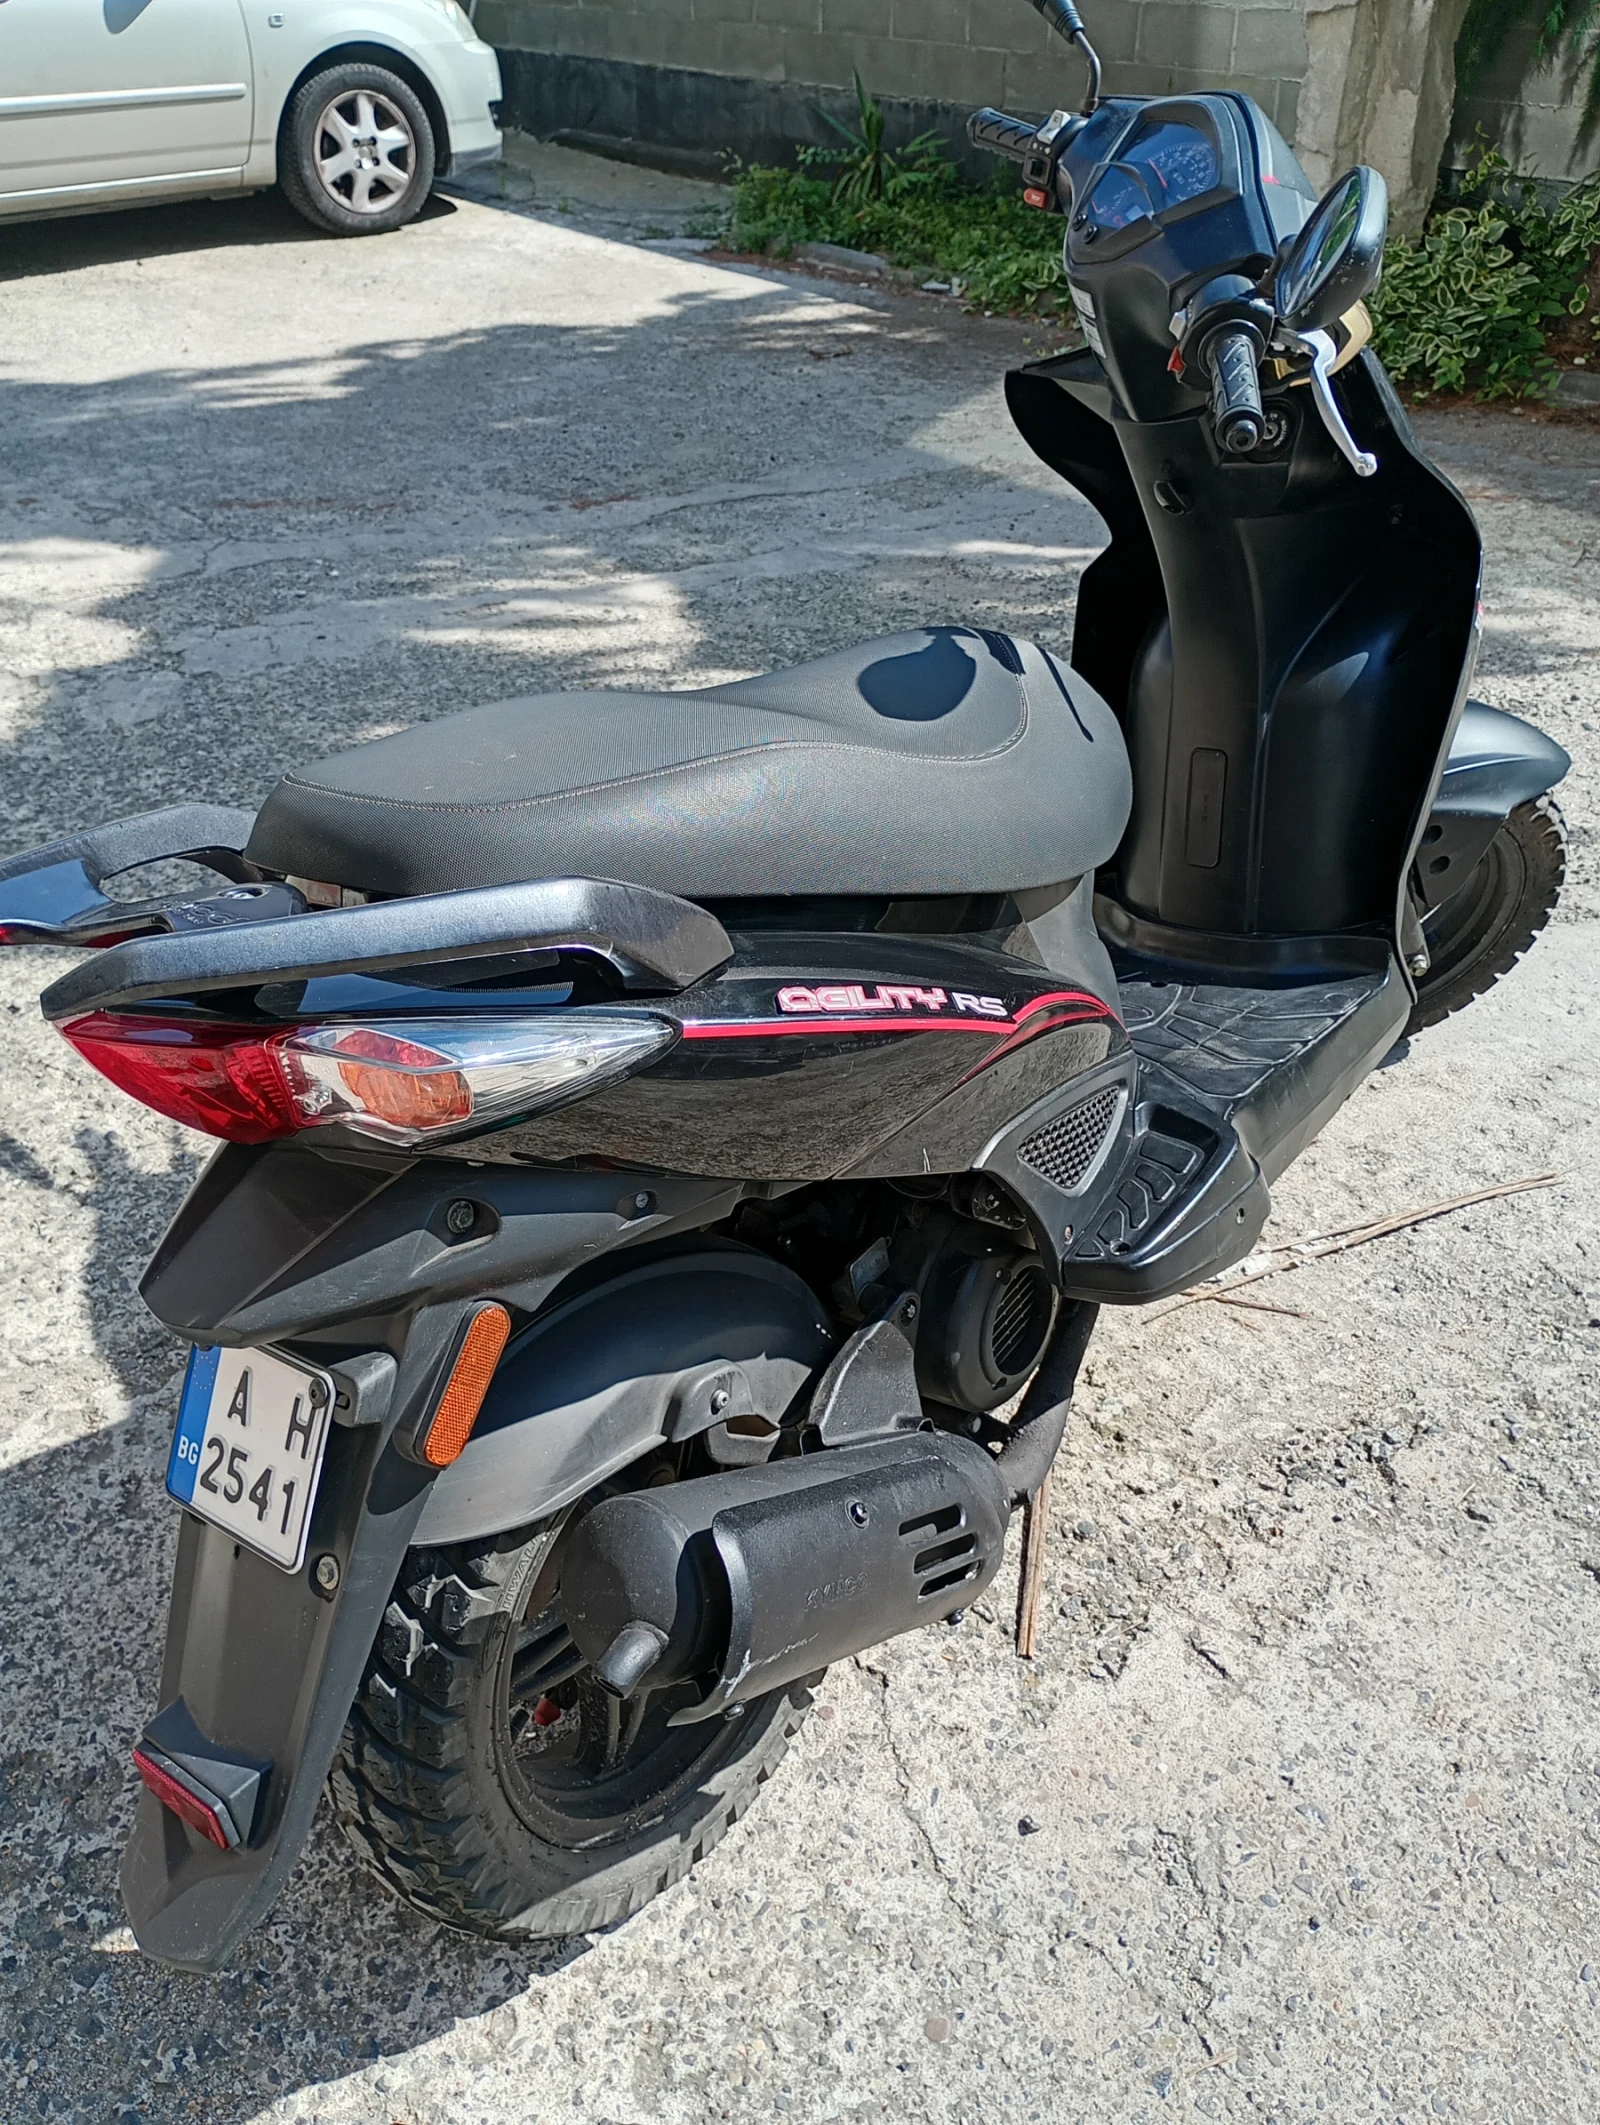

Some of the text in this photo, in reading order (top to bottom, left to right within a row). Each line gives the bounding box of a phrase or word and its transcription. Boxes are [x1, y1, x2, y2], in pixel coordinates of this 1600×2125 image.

[777, 985, 1008, 1016] AGILITY RS
[227, 1368, 317, 1460] A H
[177, 1435, 199, 1466] BG
[200, 1437, 296, 1535] 2541
